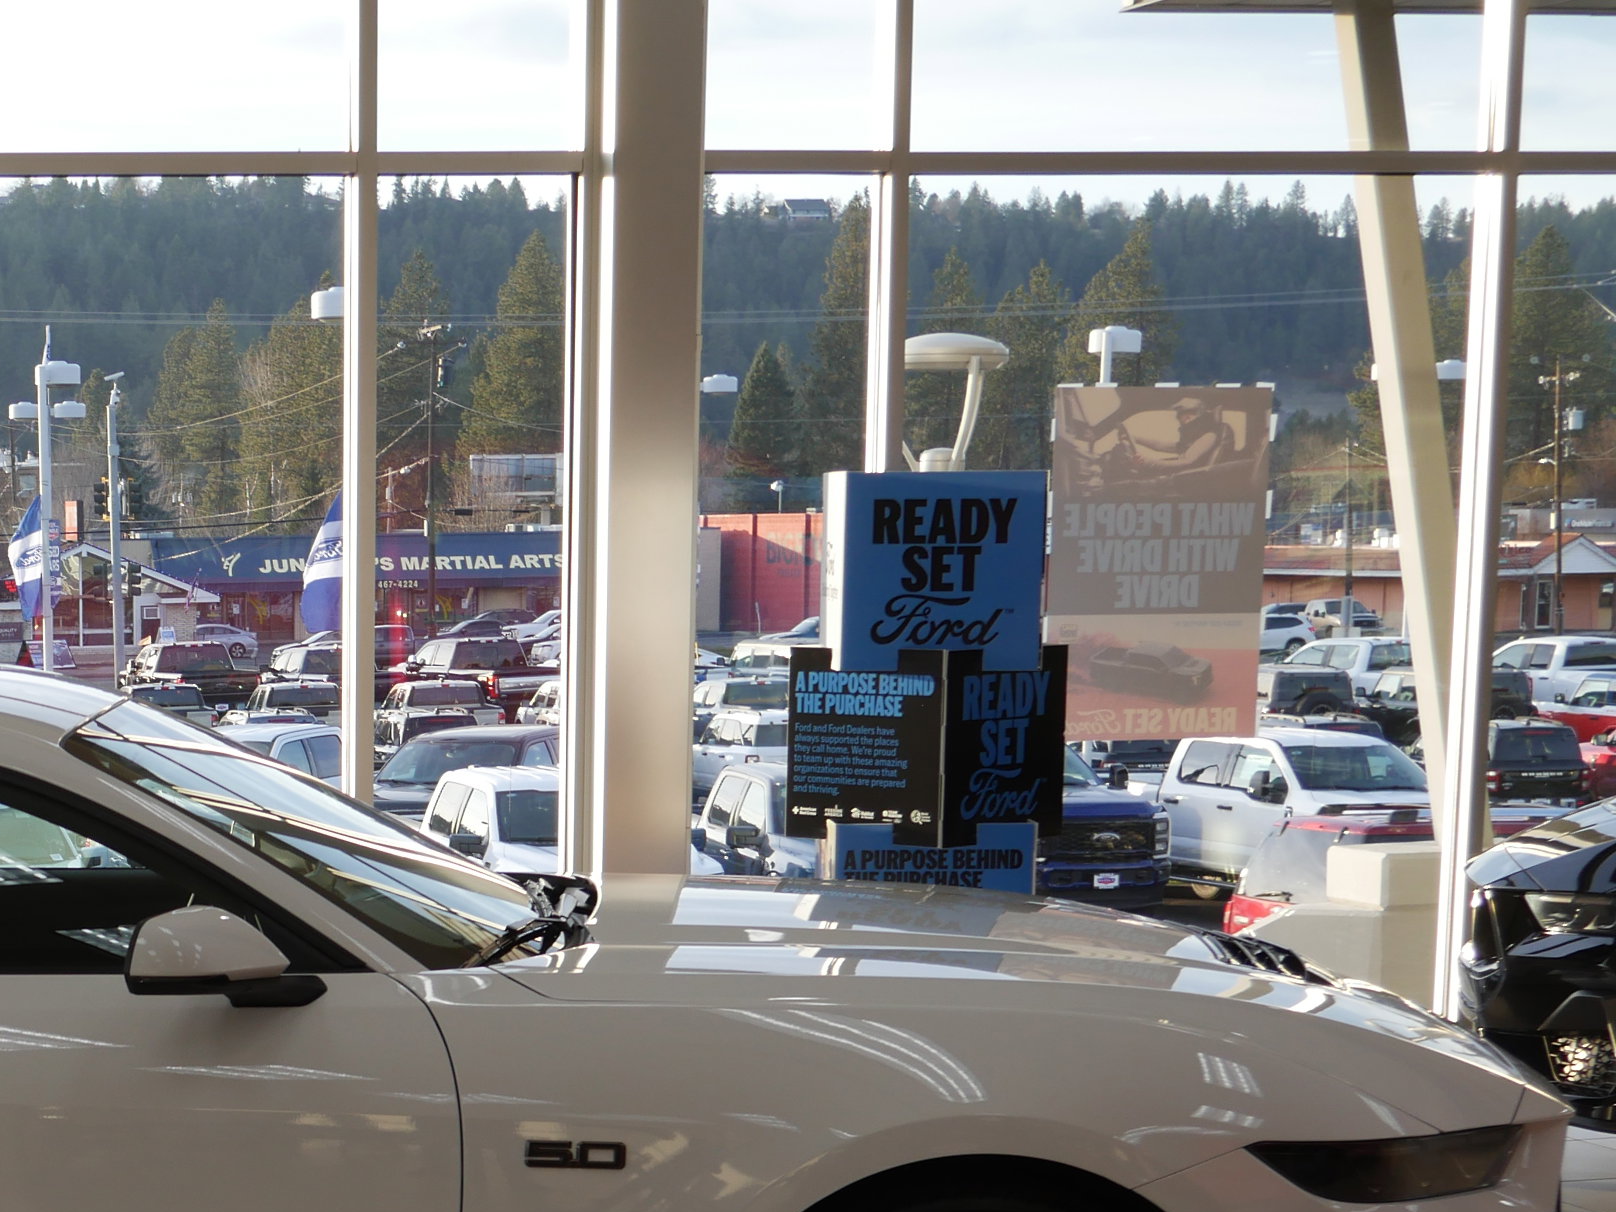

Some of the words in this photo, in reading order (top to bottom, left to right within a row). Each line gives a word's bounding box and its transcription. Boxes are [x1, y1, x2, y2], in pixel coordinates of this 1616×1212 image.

[872, 498, 1018, 545] READY
[259, 557, 305, 574] JUN
[401, 555, 503, 571] MARTIAL
[901, 546, 982, 592] SET
[377, 580, 419, 589] 467-4224
[870, 594, 1005, 645] Ford
[795, 671, 806, 692] A
[808, 672, 877, 694] PURPOSE
[879, 674, 936, 696] BEHIND
[795, 693, 823, 714] THE
[825, 694, 904, 717] PURCHASE
[962, 671, 1051, 721] READY
[794, 723, 812, 732] Ford
[813, 724, 827, 733] and
[828, 724, 845, 733] Ford
[846, 725, 876, 735] Dealers
[877, 726, 895, 735] have
[794, 733, 820, 744] always
[820, 735, 860, 746] supported
[860, 736, 874, 745] the
[874, 737, 899, 747] places
[794, 743, 811, 754] they
[812, 744, 825, 753] call
[826, 745, 849, 754] home.
[851, 746, 873, 755] We're
[873, 747, 897, 758] proud
[979, 718, 1030, 767] SET
[793, 764, 844, 775] organizations
[845, 766, 853, 775] to
[854, 768, 880, 776] ensure
[881, 769, 897, 778] that
[794, 754, 802, 762] to
[803, 755, 823, 763] team
[824, 756, 834, 765] up
[835, 755, 851, 765] with
[852, 756, 873, 766] these
[874, 758, 908, 769] amazing
[793, 784, 808, 793] and
[808, 785, 840, 796] thriving.
[807, 775, 857, 785] communities
[857, 778, 869, 786] are
[870, 778, 906, 788] prepared
[960, 767, 1042, 820] Ford
[844, 850, 856, 870] A
[861, 849, 948, 870] PURPOSE
[953, 849, 1024, 870] BEHIND
[524, 1139, 627, 1170] 5.0
